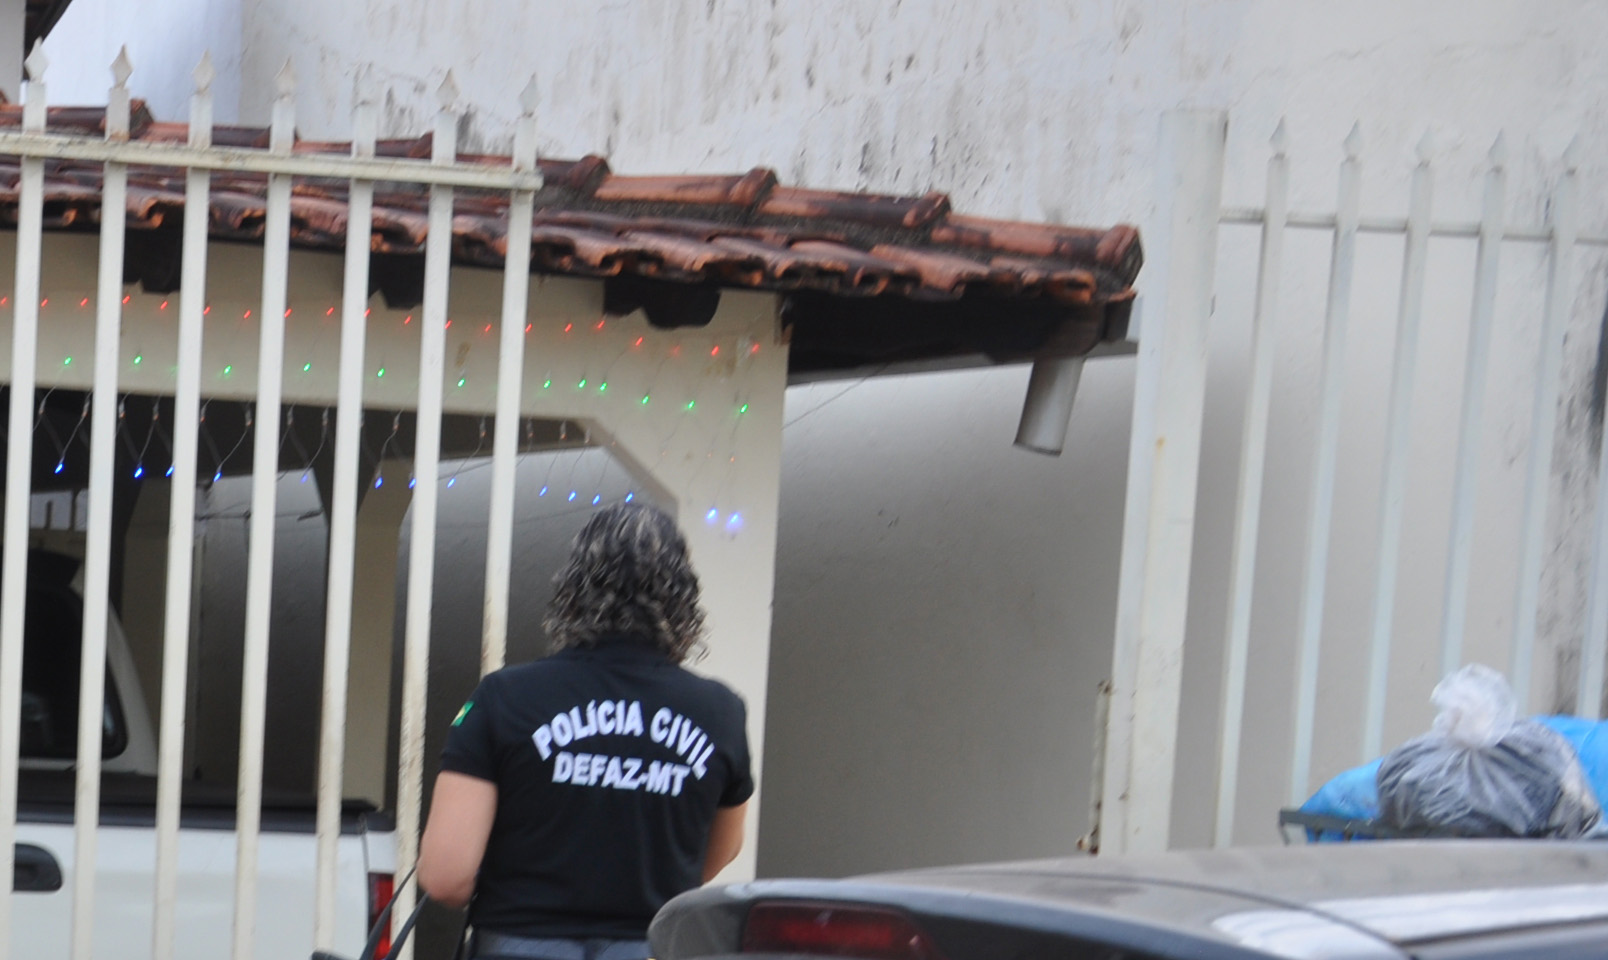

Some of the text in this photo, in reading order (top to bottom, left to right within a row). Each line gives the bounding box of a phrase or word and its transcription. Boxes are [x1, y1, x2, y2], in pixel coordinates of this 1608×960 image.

[532, 699, 715, 781] POLÍCIA CIVIL
[552, 751, 691, 797] DEFAZ-MT
